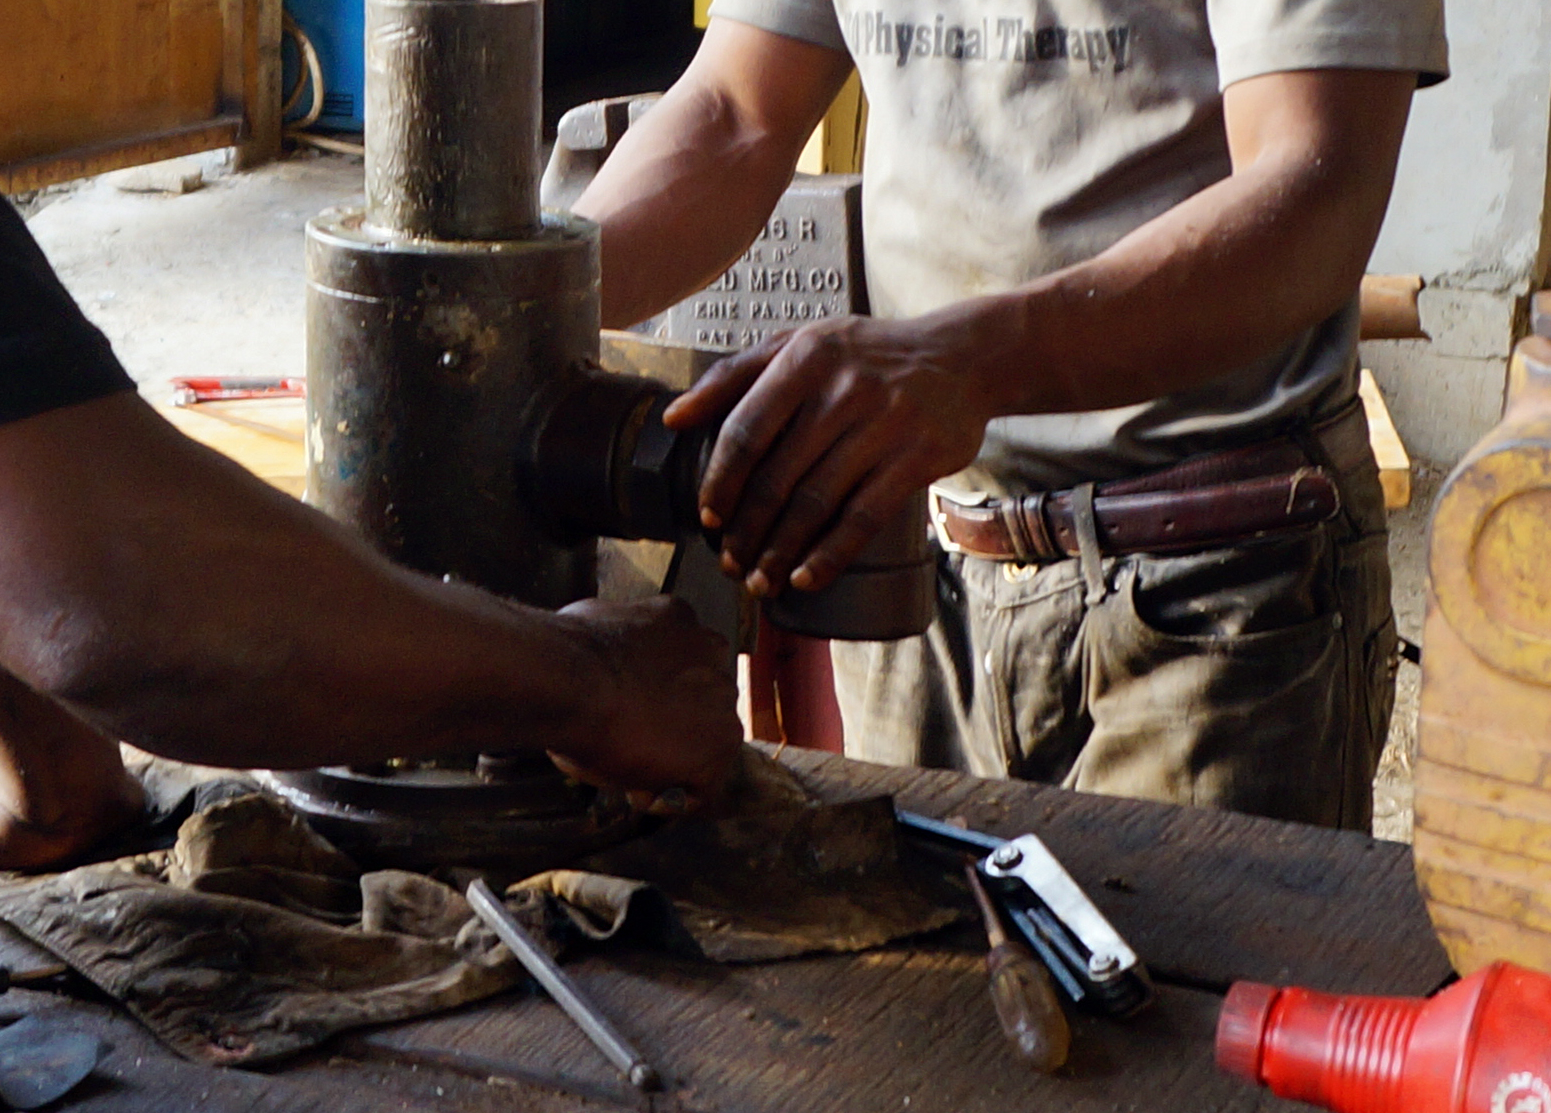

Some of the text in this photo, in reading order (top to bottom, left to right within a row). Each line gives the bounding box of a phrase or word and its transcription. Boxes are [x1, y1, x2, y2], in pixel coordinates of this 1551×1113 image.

[865, 12, 987, 68] Physical
[996, 17, 1130, 74] Therapy
[694, 300, 738, 320] ERIE
